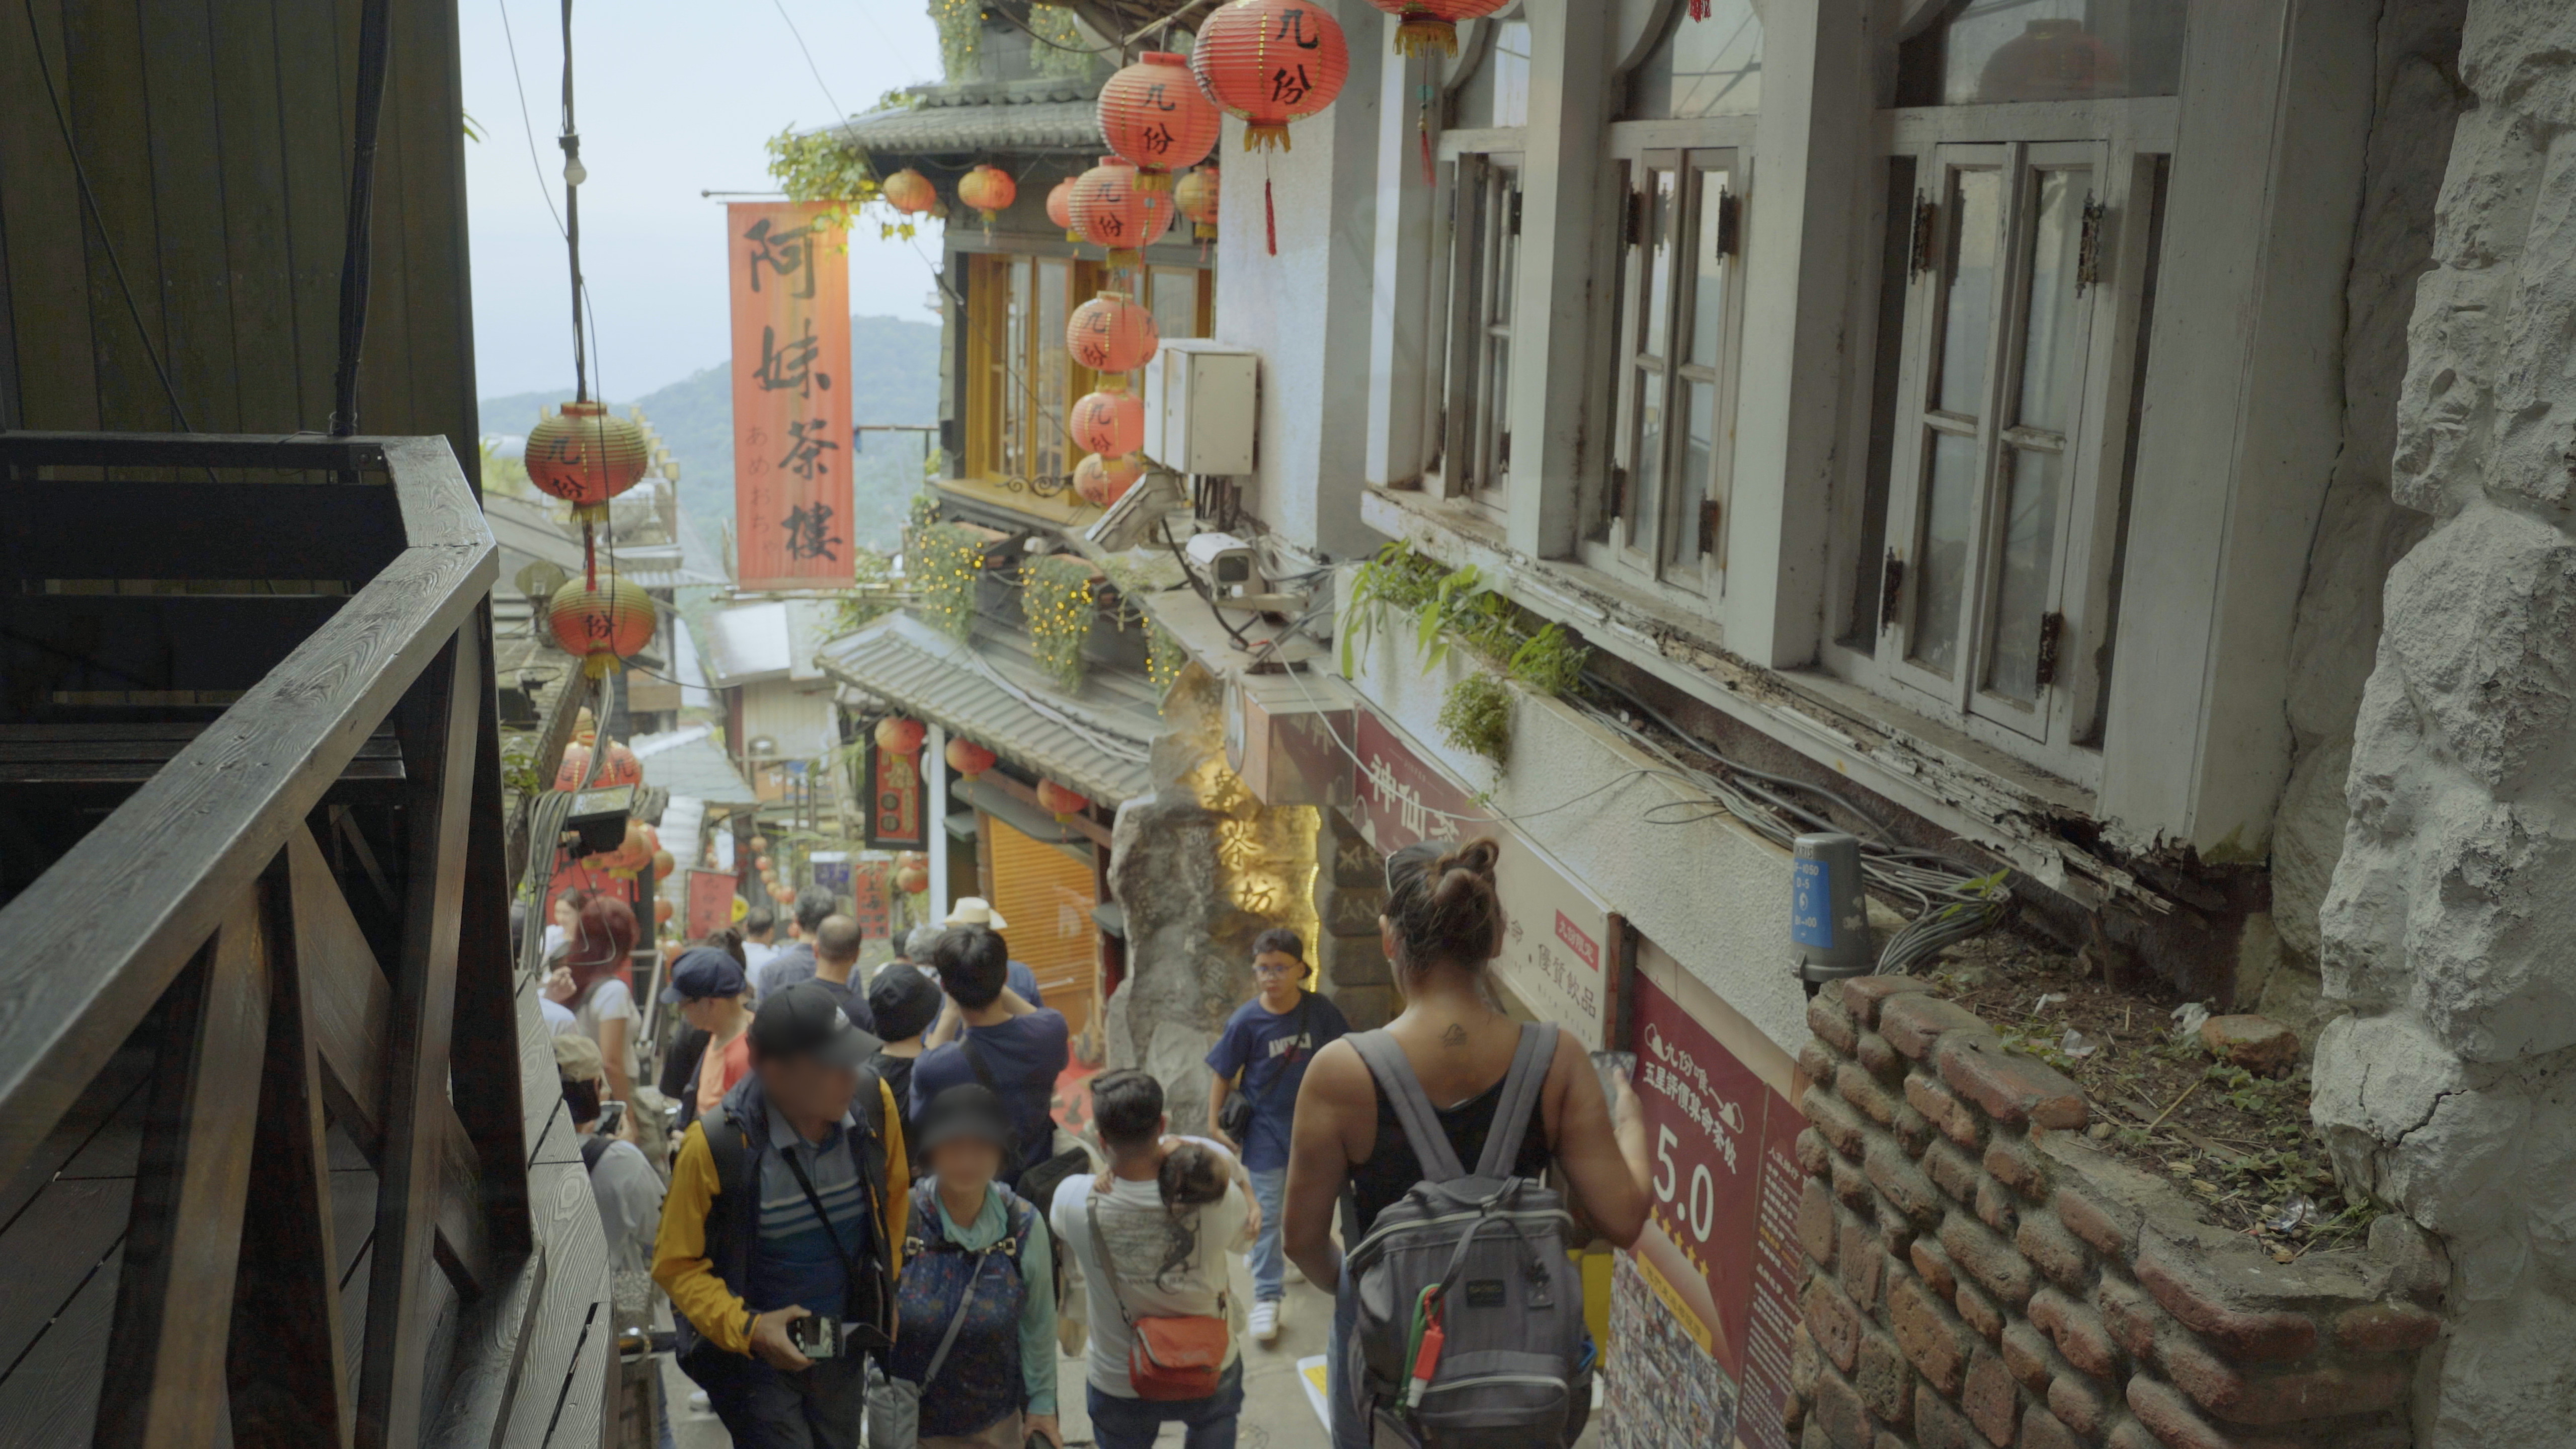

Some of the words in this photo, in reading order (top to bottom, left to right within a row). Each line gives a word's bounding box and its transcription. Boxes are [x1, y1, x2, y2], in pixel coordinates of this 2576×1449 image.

[1272, 9, 1320, 105] 九份
[1143, 83, 1176, 155] 九份
[1095, 183, 1123, 237] 九份
[1082, 311, 1107, 367] 九份
[744, 218, 842, 561] 阿妹茶樓
[1089, 403, 1111, 453] 九份
[547, 436, 587, 500] 九份
[1665, 1042, 1724, 1110] 九份唯一
[1653, 1123, 1714, 1243] 5.0
